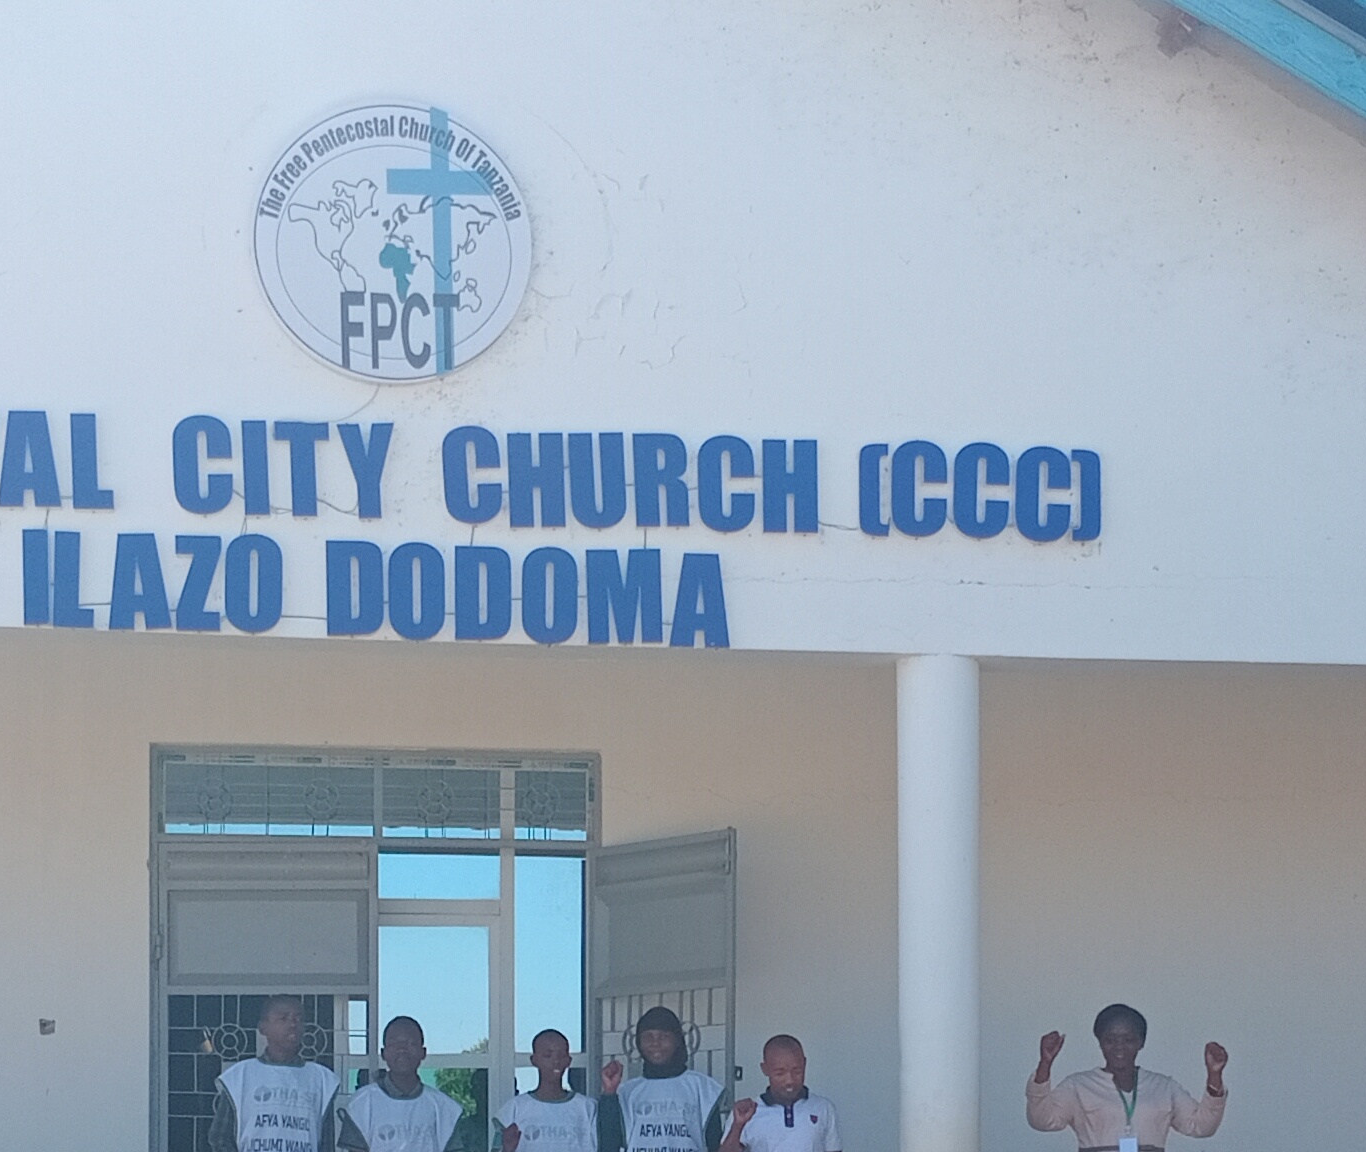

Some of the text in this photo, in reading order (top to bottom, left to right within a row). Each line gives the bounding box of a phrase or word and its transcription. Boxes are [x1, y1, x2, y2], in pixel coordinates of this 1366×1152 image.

[259, 115, 522, 221] The Free Pentecostal Church Of Tanzania
[340, 291, 460, 370] FPCT
[172, 414, 394, 519] CITY
[441, 425, 818, 533] CHURCH
[22, 529, 731, 649] ILAZO DODOMA
[255, 1113, 279, 1128] AFYA
[639, 1123, 662, 1138] AFYA
